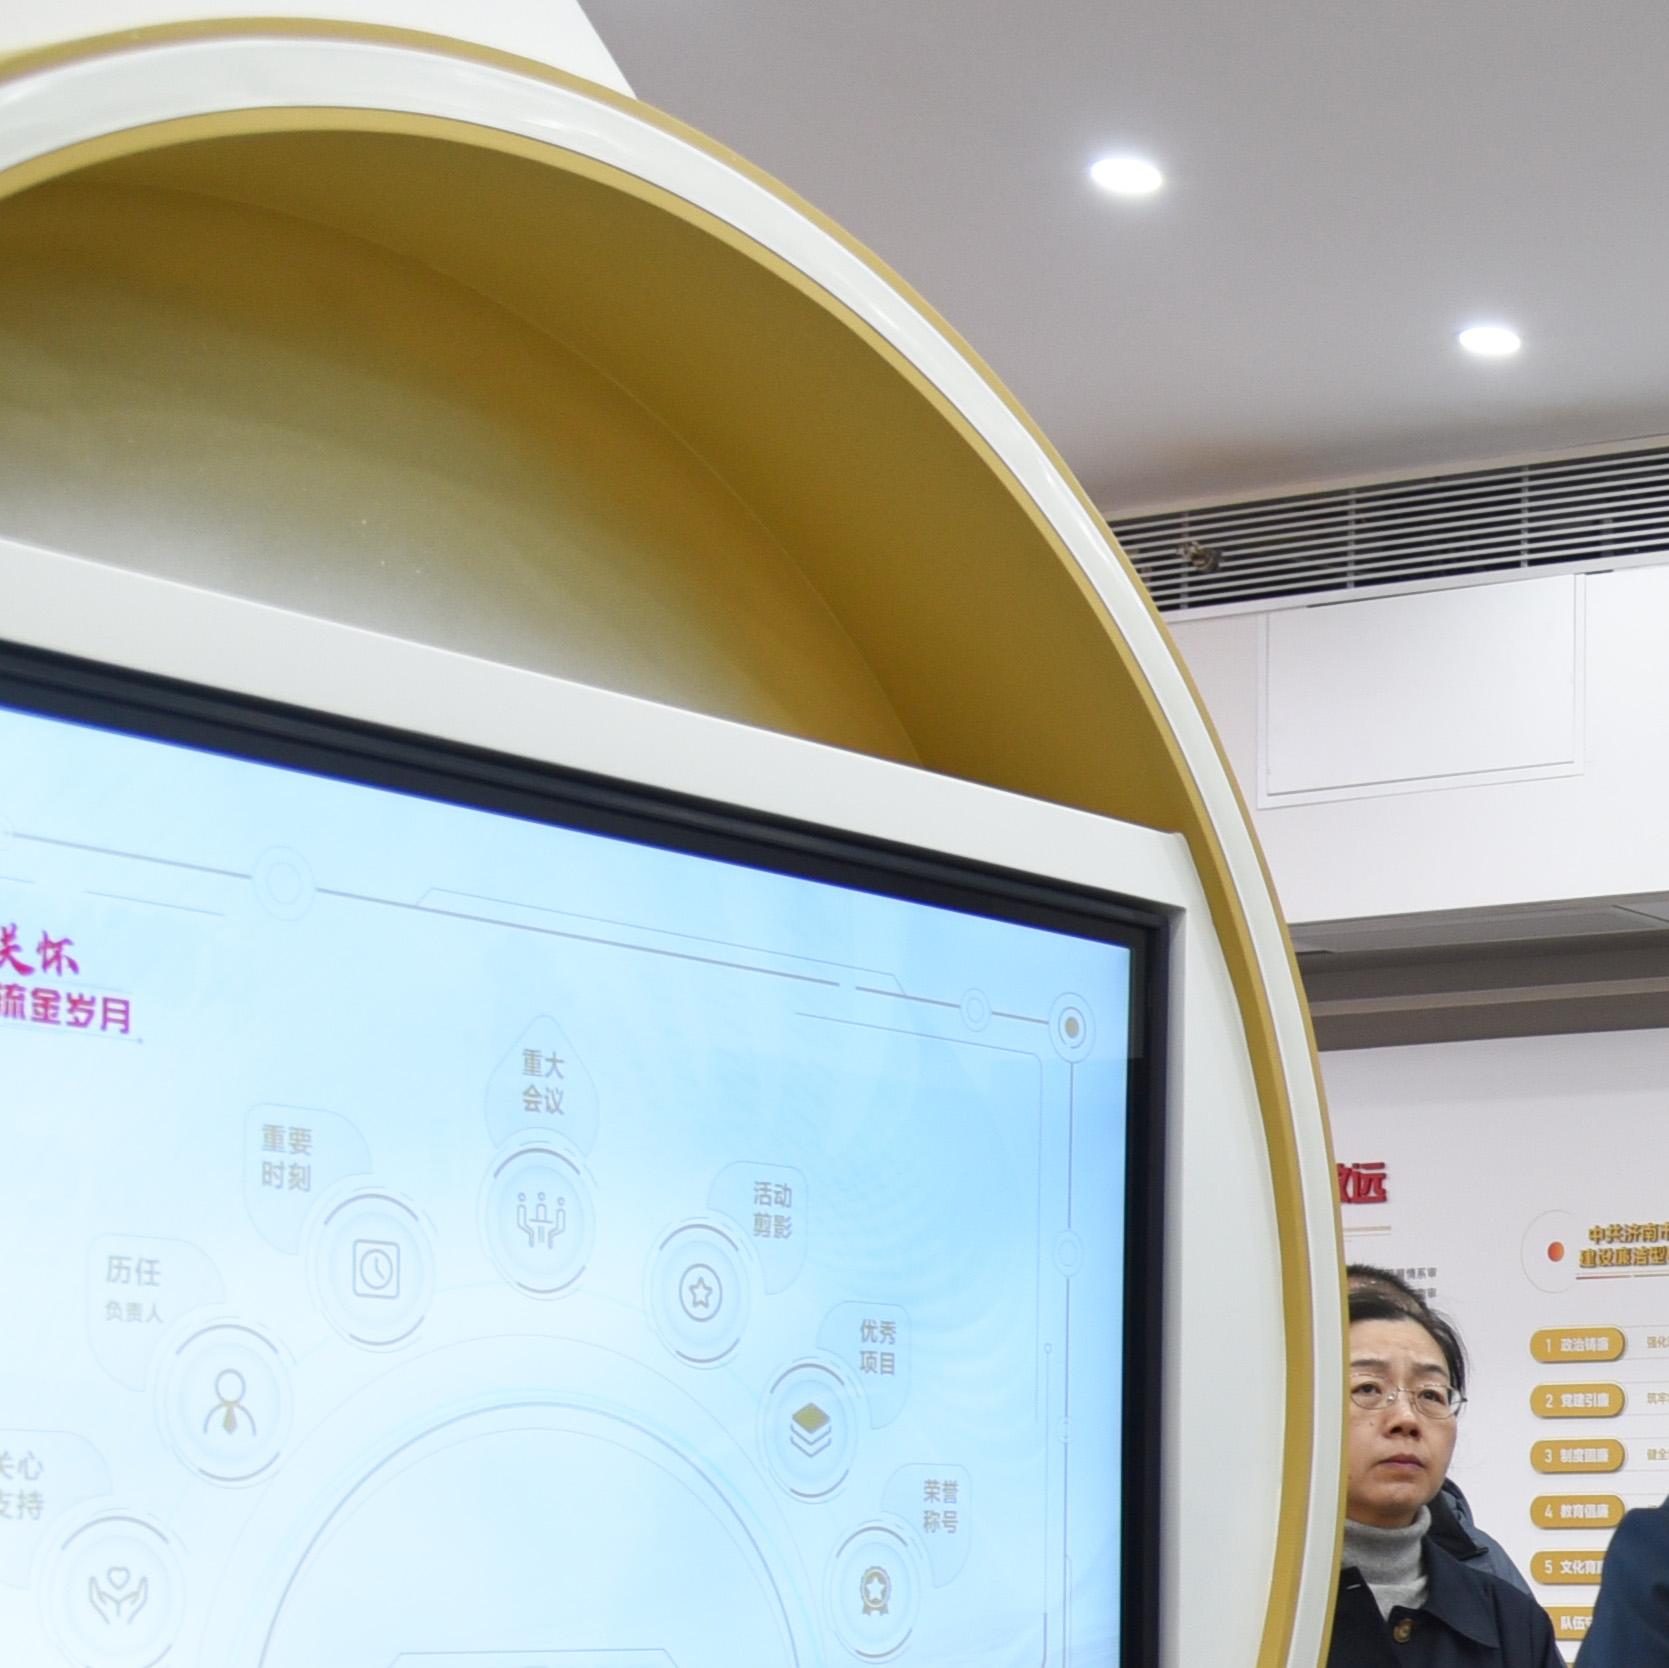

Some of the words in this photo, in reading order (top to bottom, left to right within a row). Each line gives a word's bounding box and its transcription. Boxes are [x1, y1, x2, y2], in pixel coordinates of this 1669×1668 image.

[0, 982, 131, 1035] 流金岁月
[521, 1047, 565, 1081] 重大
[521, 1083, 565, 1117] 会议
[260, 1122, 314, 1157] 重要
[260, 1160, 313, 1194] 时刻
[753, 1180, 793, 1209] 活动
[752, 1211, 793, 1239] 剪影
[105, 1254, 162, 1287] 历任
[105, 1300, 164, 1324] 负责人
[859, 1318, 897, 1345] 优秀
[1545, 1338, 1552, 1353] 1
[859, 1350, 896, 1377] 项目
[1545, 1393, 1553, 1408] 2
[1544, 1448, 1553, 1463] 3
[923, 1479, 959, 1506] 荣誉
[923, 1509, 959, 1535] 称号
[1544, 1504, 1553, 1518] 4
[1544, 1560, 1553, 1574] 5
